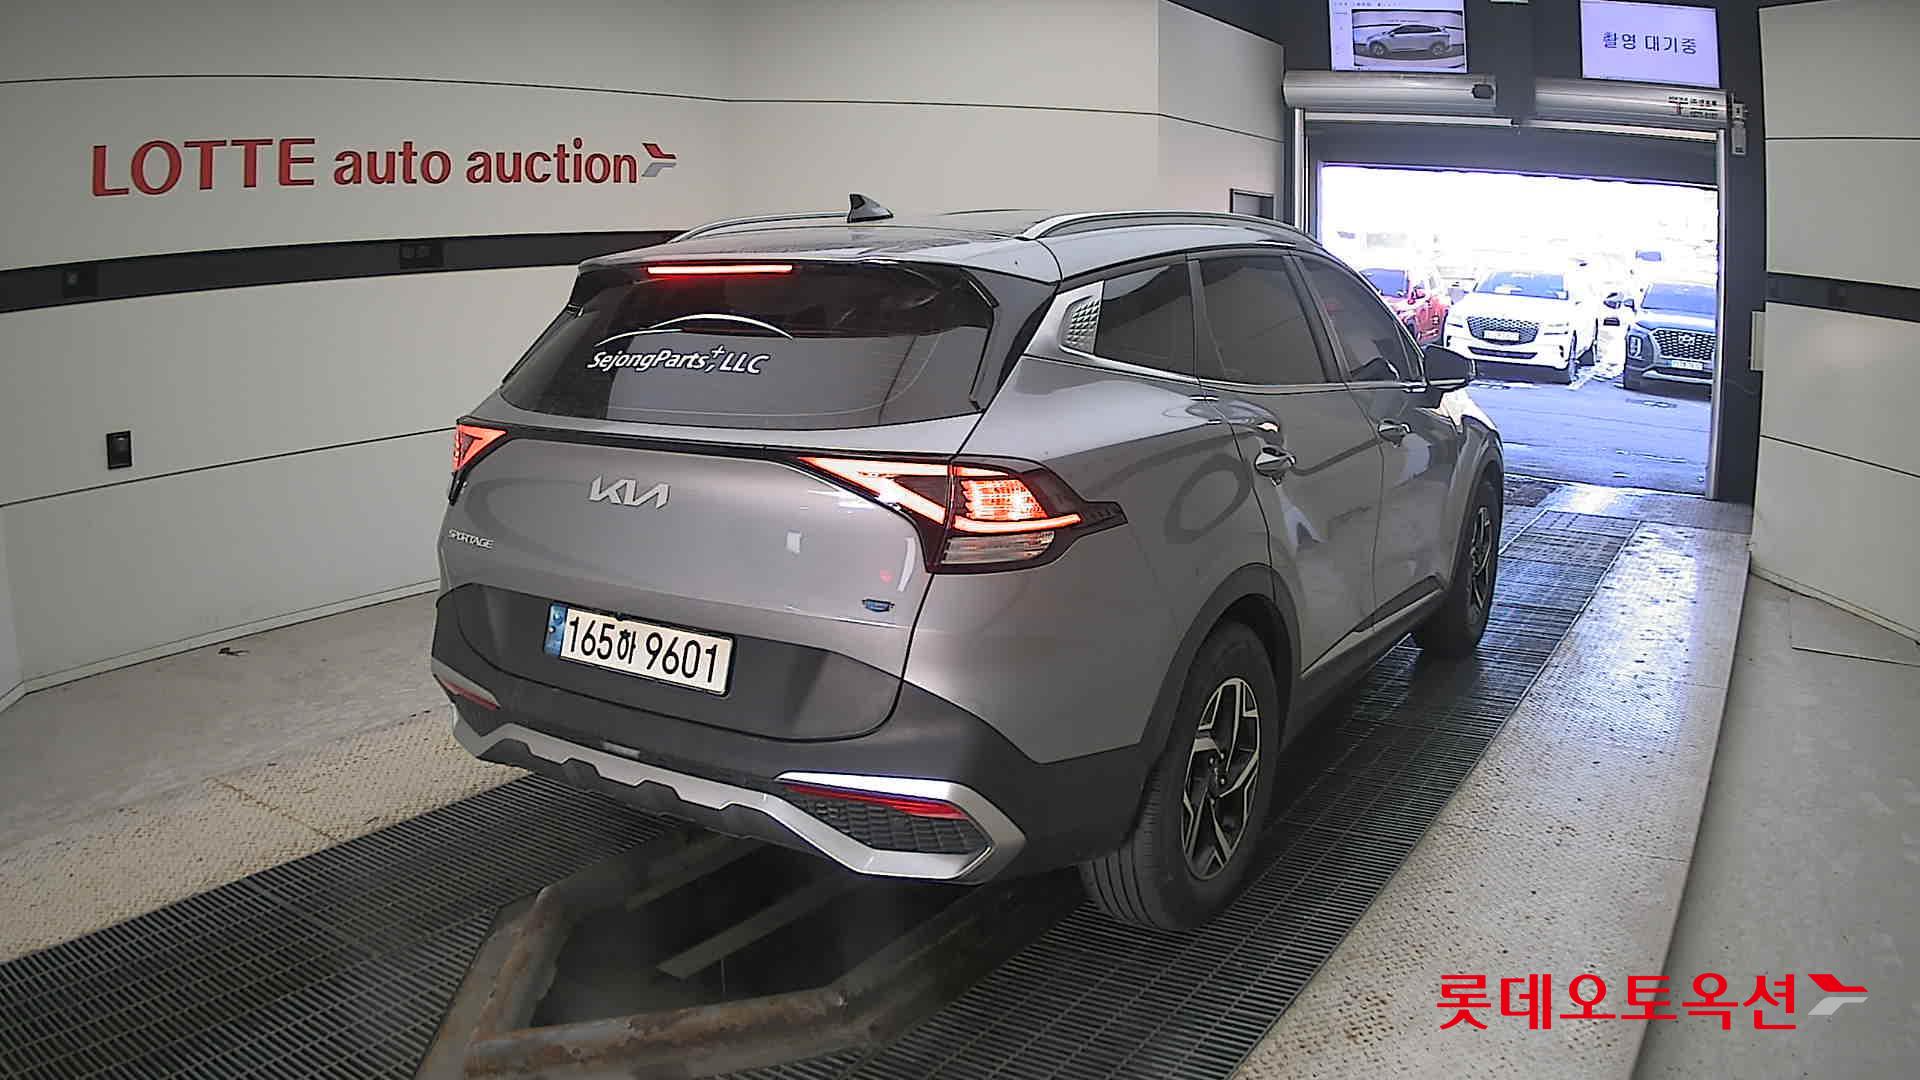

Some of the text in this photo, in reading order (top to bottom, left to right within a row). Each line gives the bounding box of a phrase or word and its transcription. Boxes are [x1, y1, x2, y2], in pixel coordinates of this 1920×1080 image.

[1645, 34, 1697, 55] 대기중
[91, 137, 639, 198] LOTTE auto auction
[568, 616, 719, 683] 165하 9601
